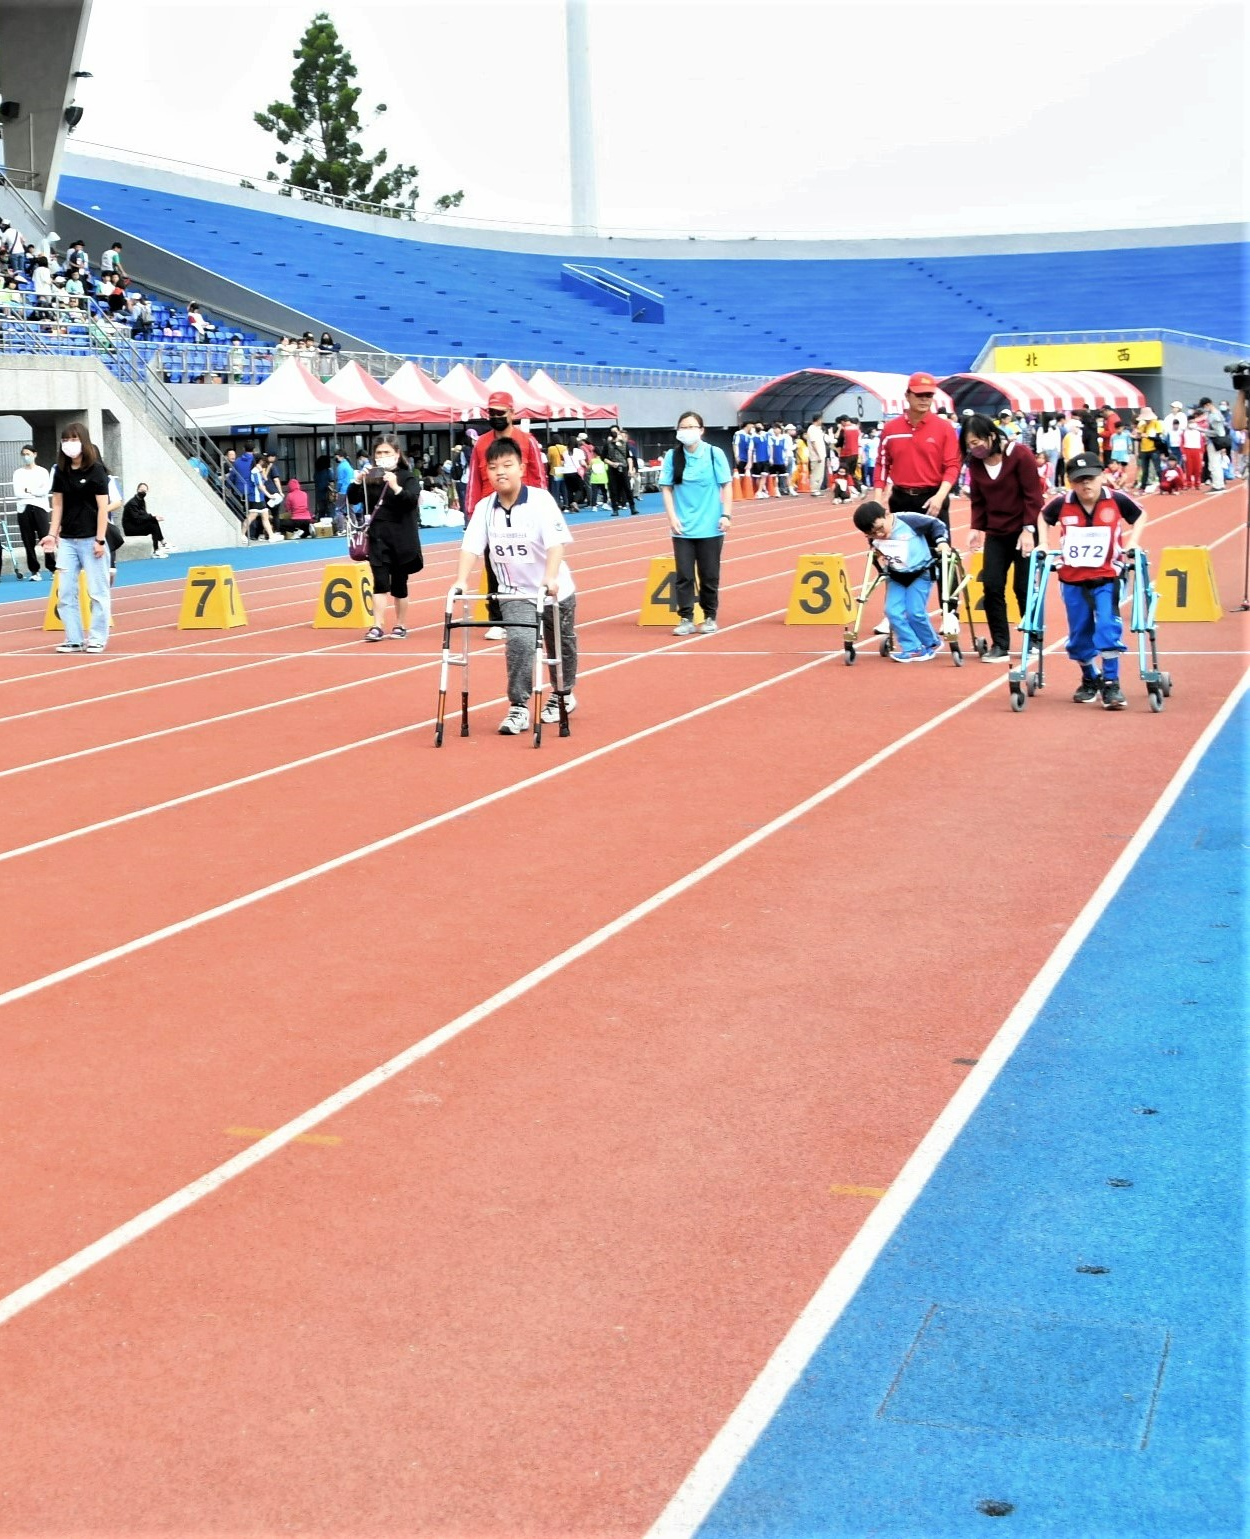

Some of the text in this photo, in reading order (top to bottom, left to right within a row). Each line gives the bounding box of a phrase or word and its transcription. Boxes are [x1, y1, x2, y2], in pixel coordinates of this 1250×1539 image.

[494, 544, 527, 557] 815
[1068, 545, 1103, 559] 872
[190, 578, 217, 618] 7
[222, 577, 234, 616] 7
[323, 577, 353, 619] 6
[360, 576, 374, 618] 6
[650, 571, 678, 613] 4
[798, 569, 832, 615] 3
[839, 569, 852, 612] 3
[1165, 567, 1188, 608] 1
